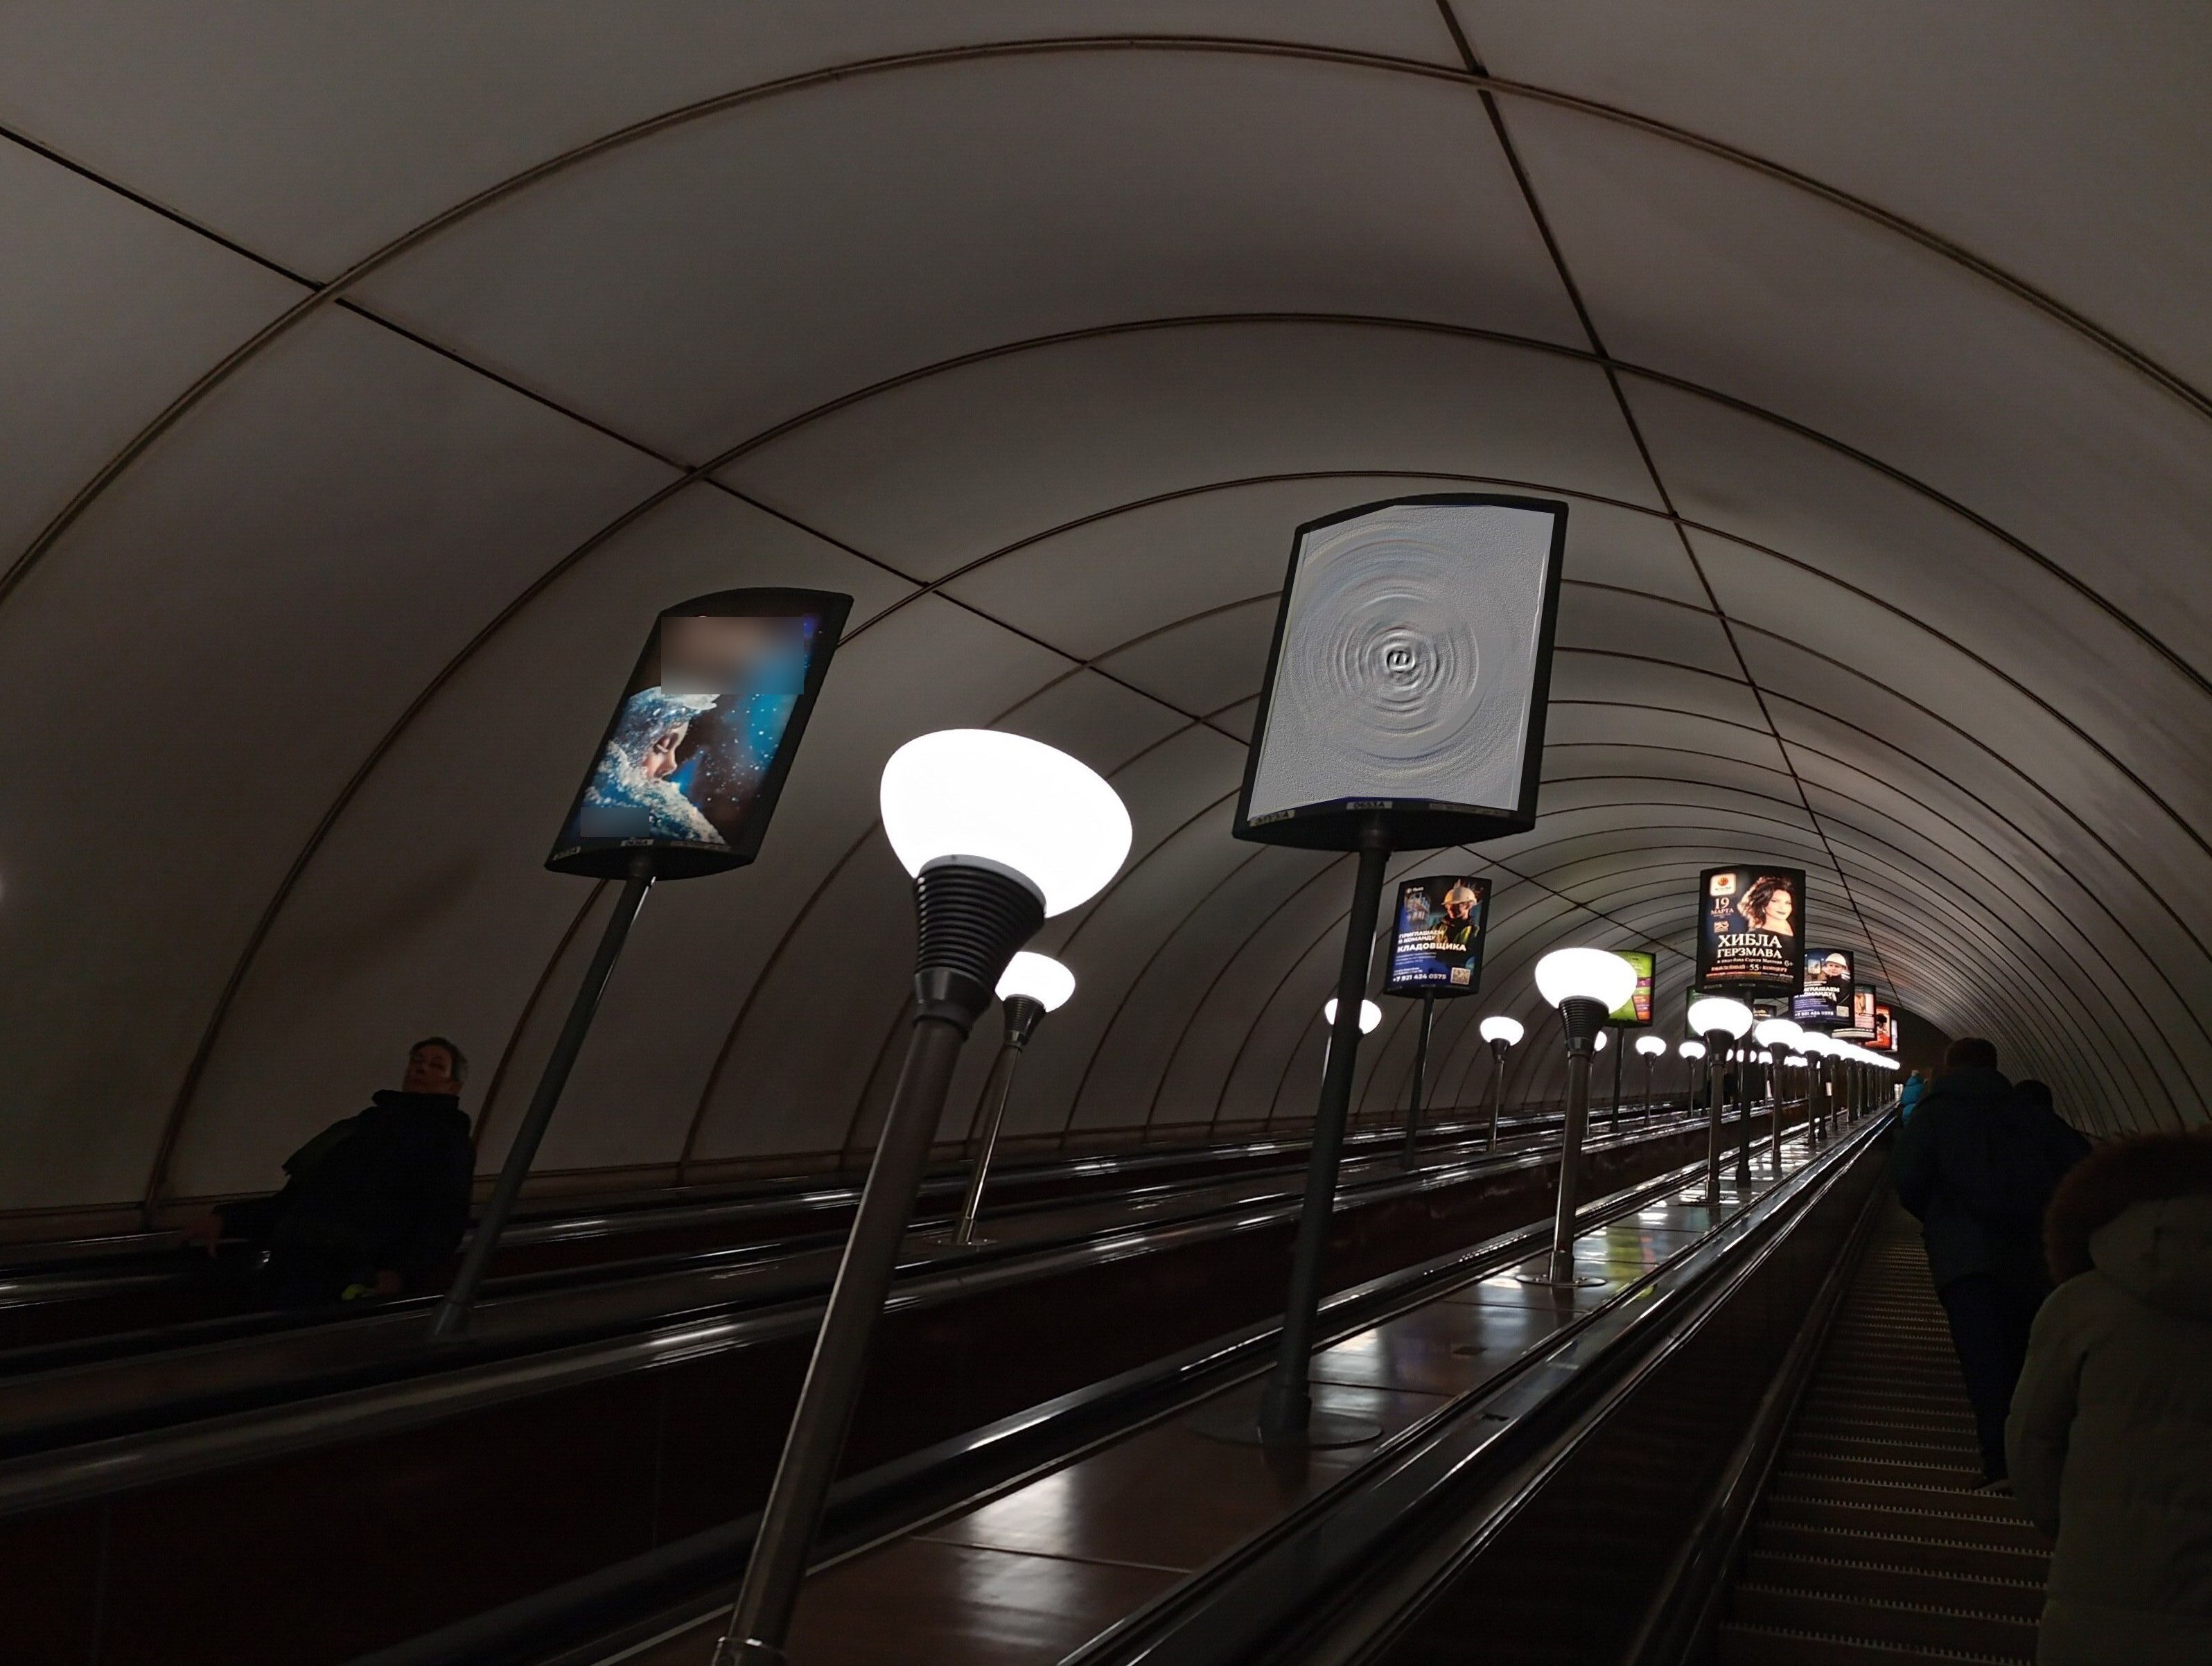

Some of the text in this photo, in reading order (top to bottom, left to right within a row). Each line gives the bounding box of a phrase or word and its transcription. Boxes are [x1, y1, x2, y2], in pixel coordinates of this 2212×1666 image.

[1715, 897, 1730, 910] 19
[1399, 930, 1444, 939] ПРИГЛАШАЕМ
[1397, 942, 1466, 952] КЛАДОВЩИКА
[1718, 933, 1783, 949] ХИБЛА
[1717, 947, 1783, 959] ГЕРЗМАВА
